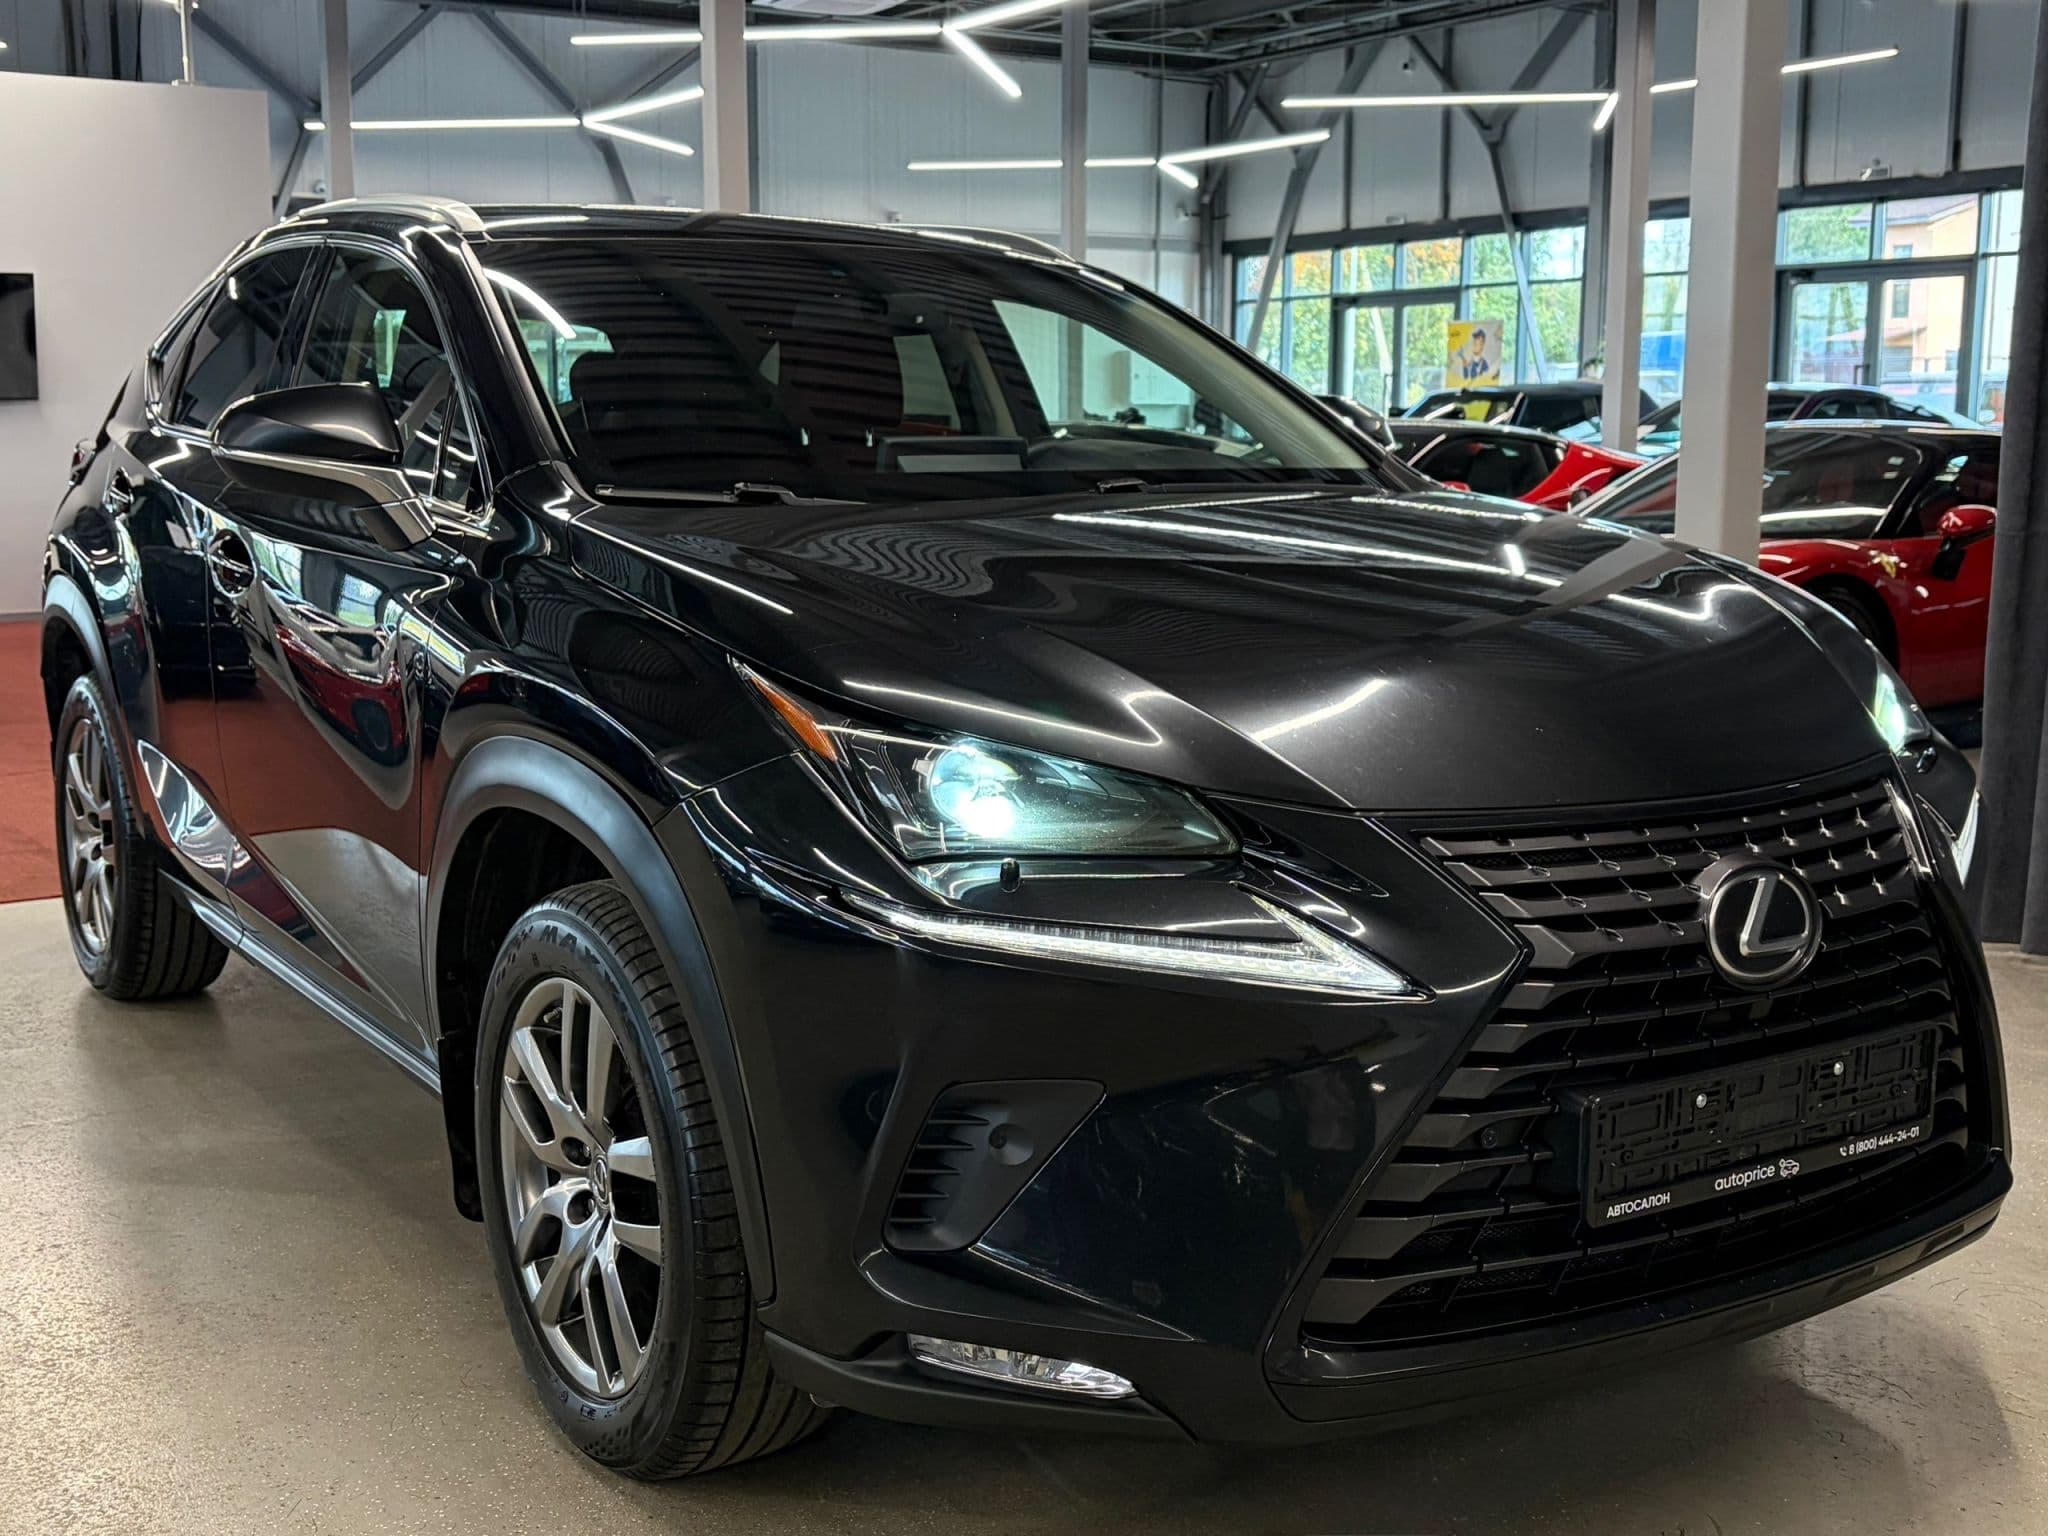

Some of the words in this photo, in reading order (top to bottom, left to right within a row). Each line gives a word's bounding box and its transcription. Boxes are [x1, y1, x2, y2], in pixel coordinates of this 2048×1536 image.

[1855, 1136, 1878, 1155] (800)
[1714, 1165, 1776, 1191] autoprice
[1606, 1192, 1671, 1219] АВТОСАЛОН
